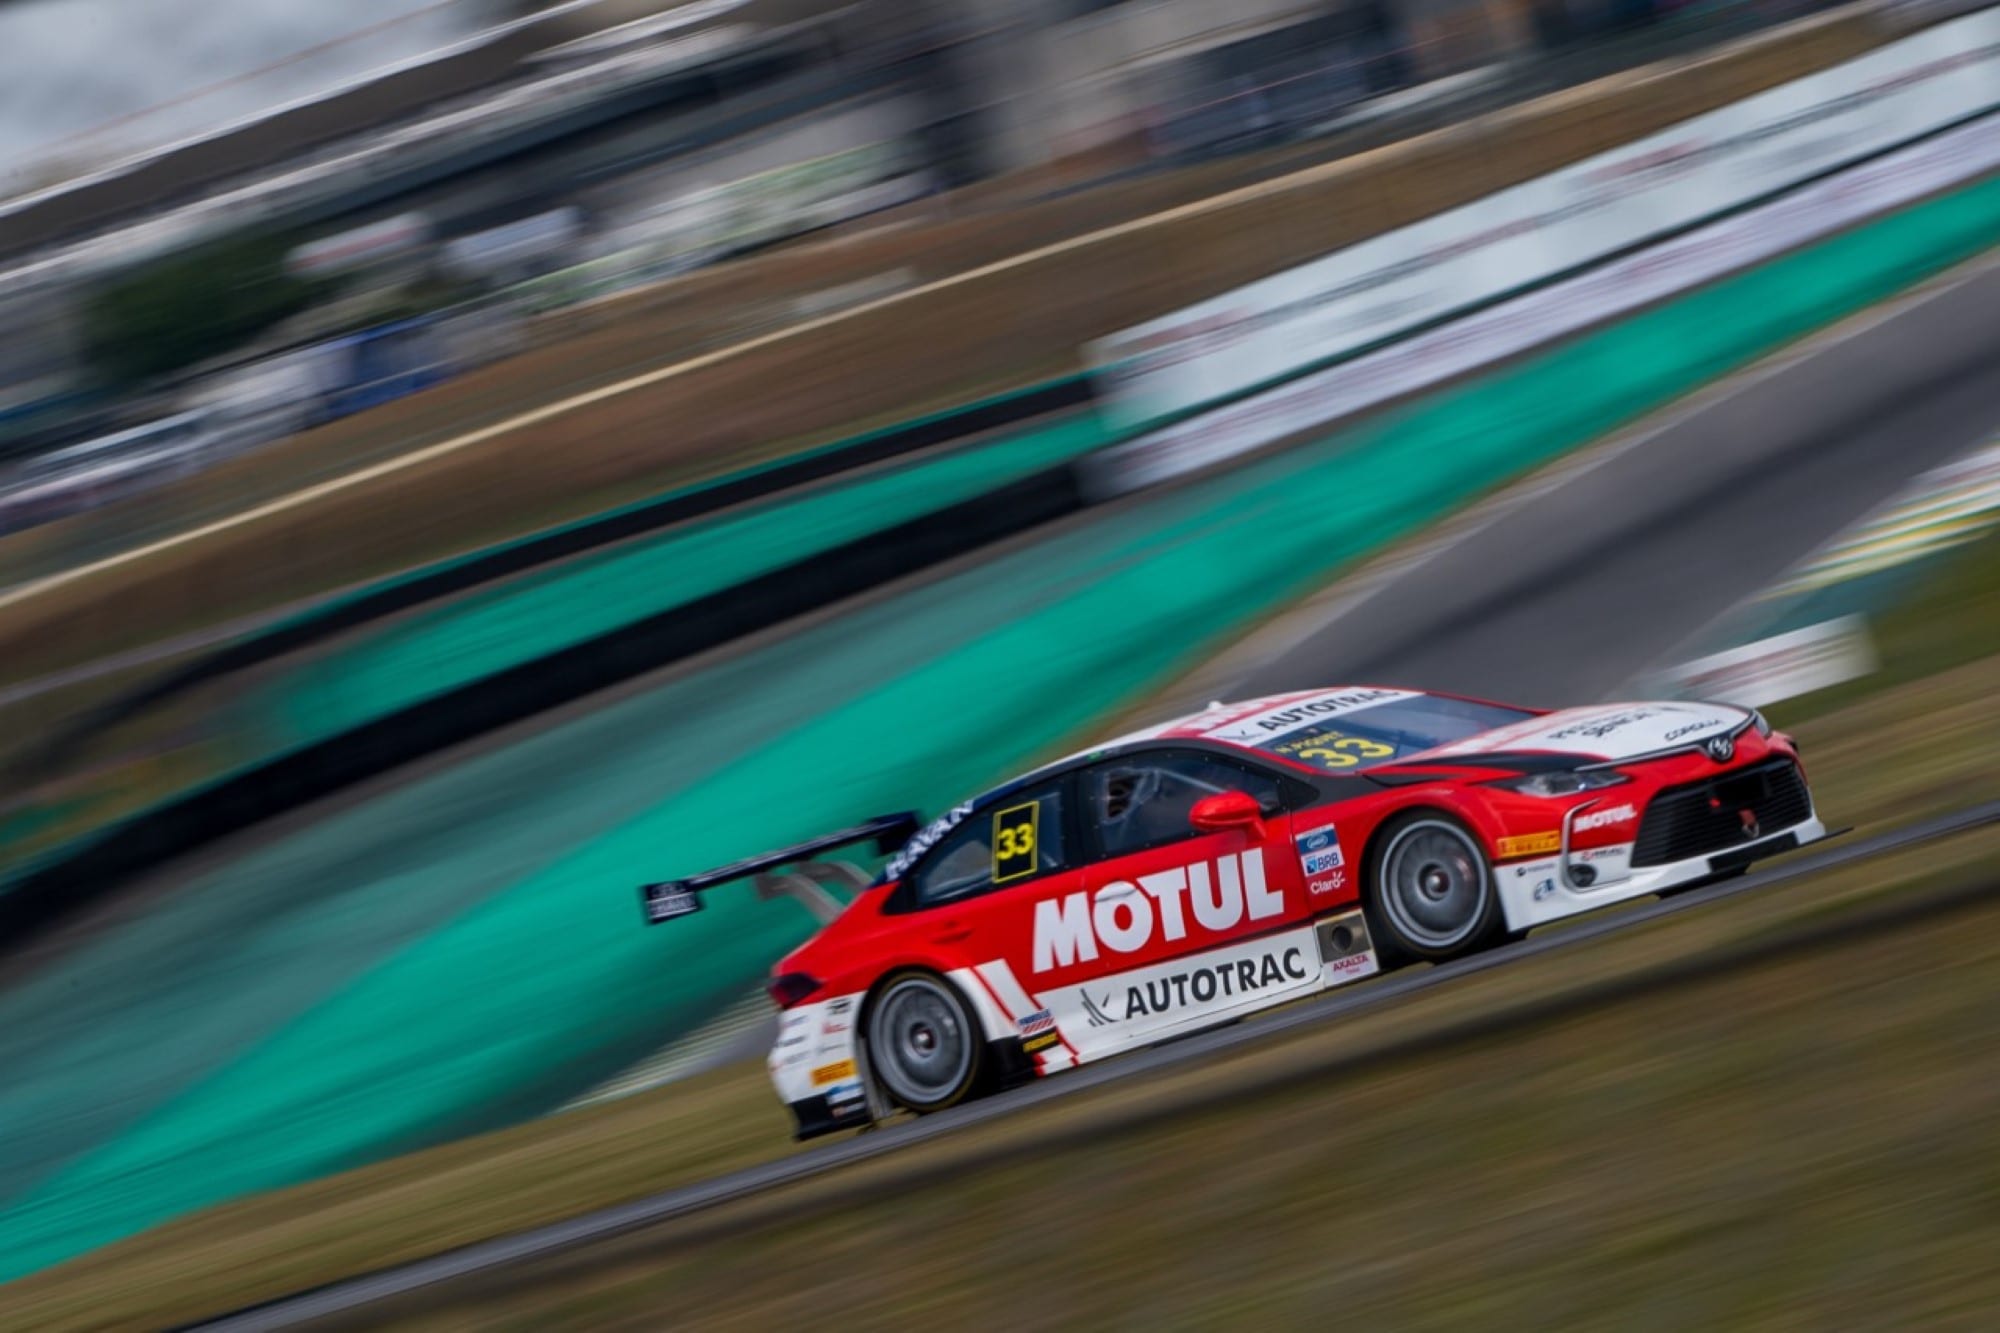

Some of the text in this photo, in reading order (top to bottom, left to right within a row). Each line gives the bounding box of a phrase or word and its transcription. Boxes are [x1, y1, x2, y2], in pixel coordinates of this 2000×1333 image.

[1299, 738, 1394, 767] 33
[996, 822, 1035, 861] 33
[1317, 852, 1340, 871] BRB
[1310, 871, 1346, 894] Claro
[1033, 847, 1285, 974] MOTUL
[1333, 954, 1369, 971] AXALTA
[1125, 947, 1307, 1020] AUTOTRAC
